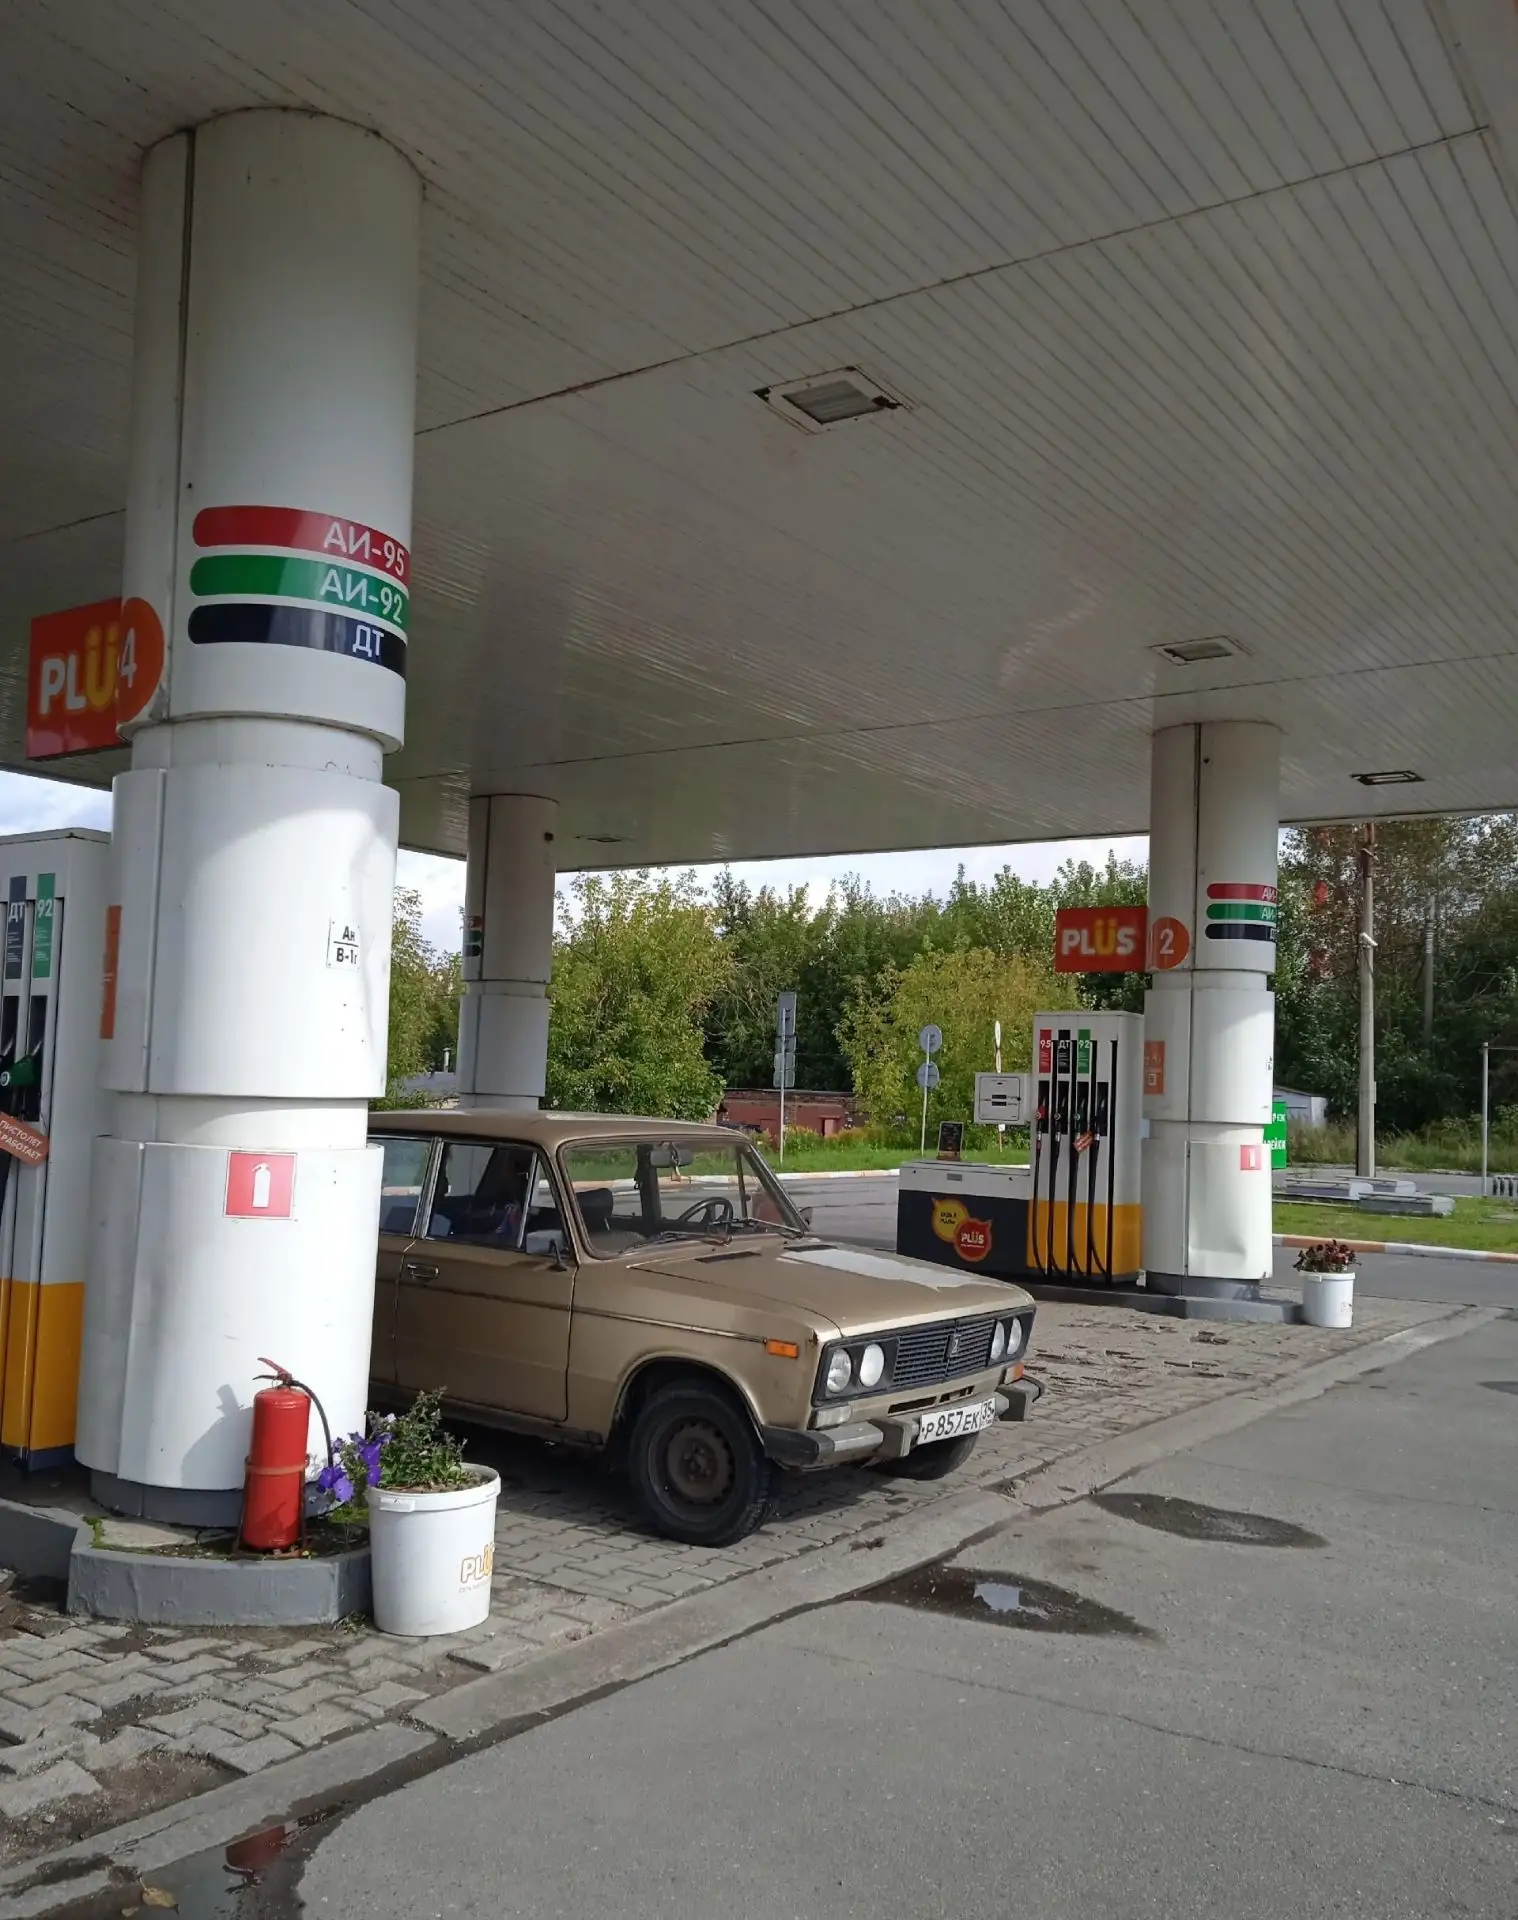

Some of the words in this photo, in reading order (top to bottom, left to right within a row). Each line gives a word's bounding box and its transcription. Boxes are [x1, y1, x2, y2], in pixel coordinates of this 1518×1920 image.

[324, 521, 405, 577] АИ-95
[319, 568, 403, 624] АИ-92
[352, 624, 385, 658] ДТ
[38, 623, 119, 715] PLÜ
[121, 627, 137, 689] 4
[8, 901, 26, 922] ДТ
[36, 899, 53, 918] 92
[1061, 919, 1137, 956] PLÜS
[1159, 928, 1175, 955] 2
[1040, 1040, 1051, 1049] 95
[1058, 1040, 1070, 1049] ДТ
[1079, 1040, 1090, 1049] 92
[0, 1119, 42, 1148] ПИСТОЛЕТ
[981, 1400, 993, 1420] 35
